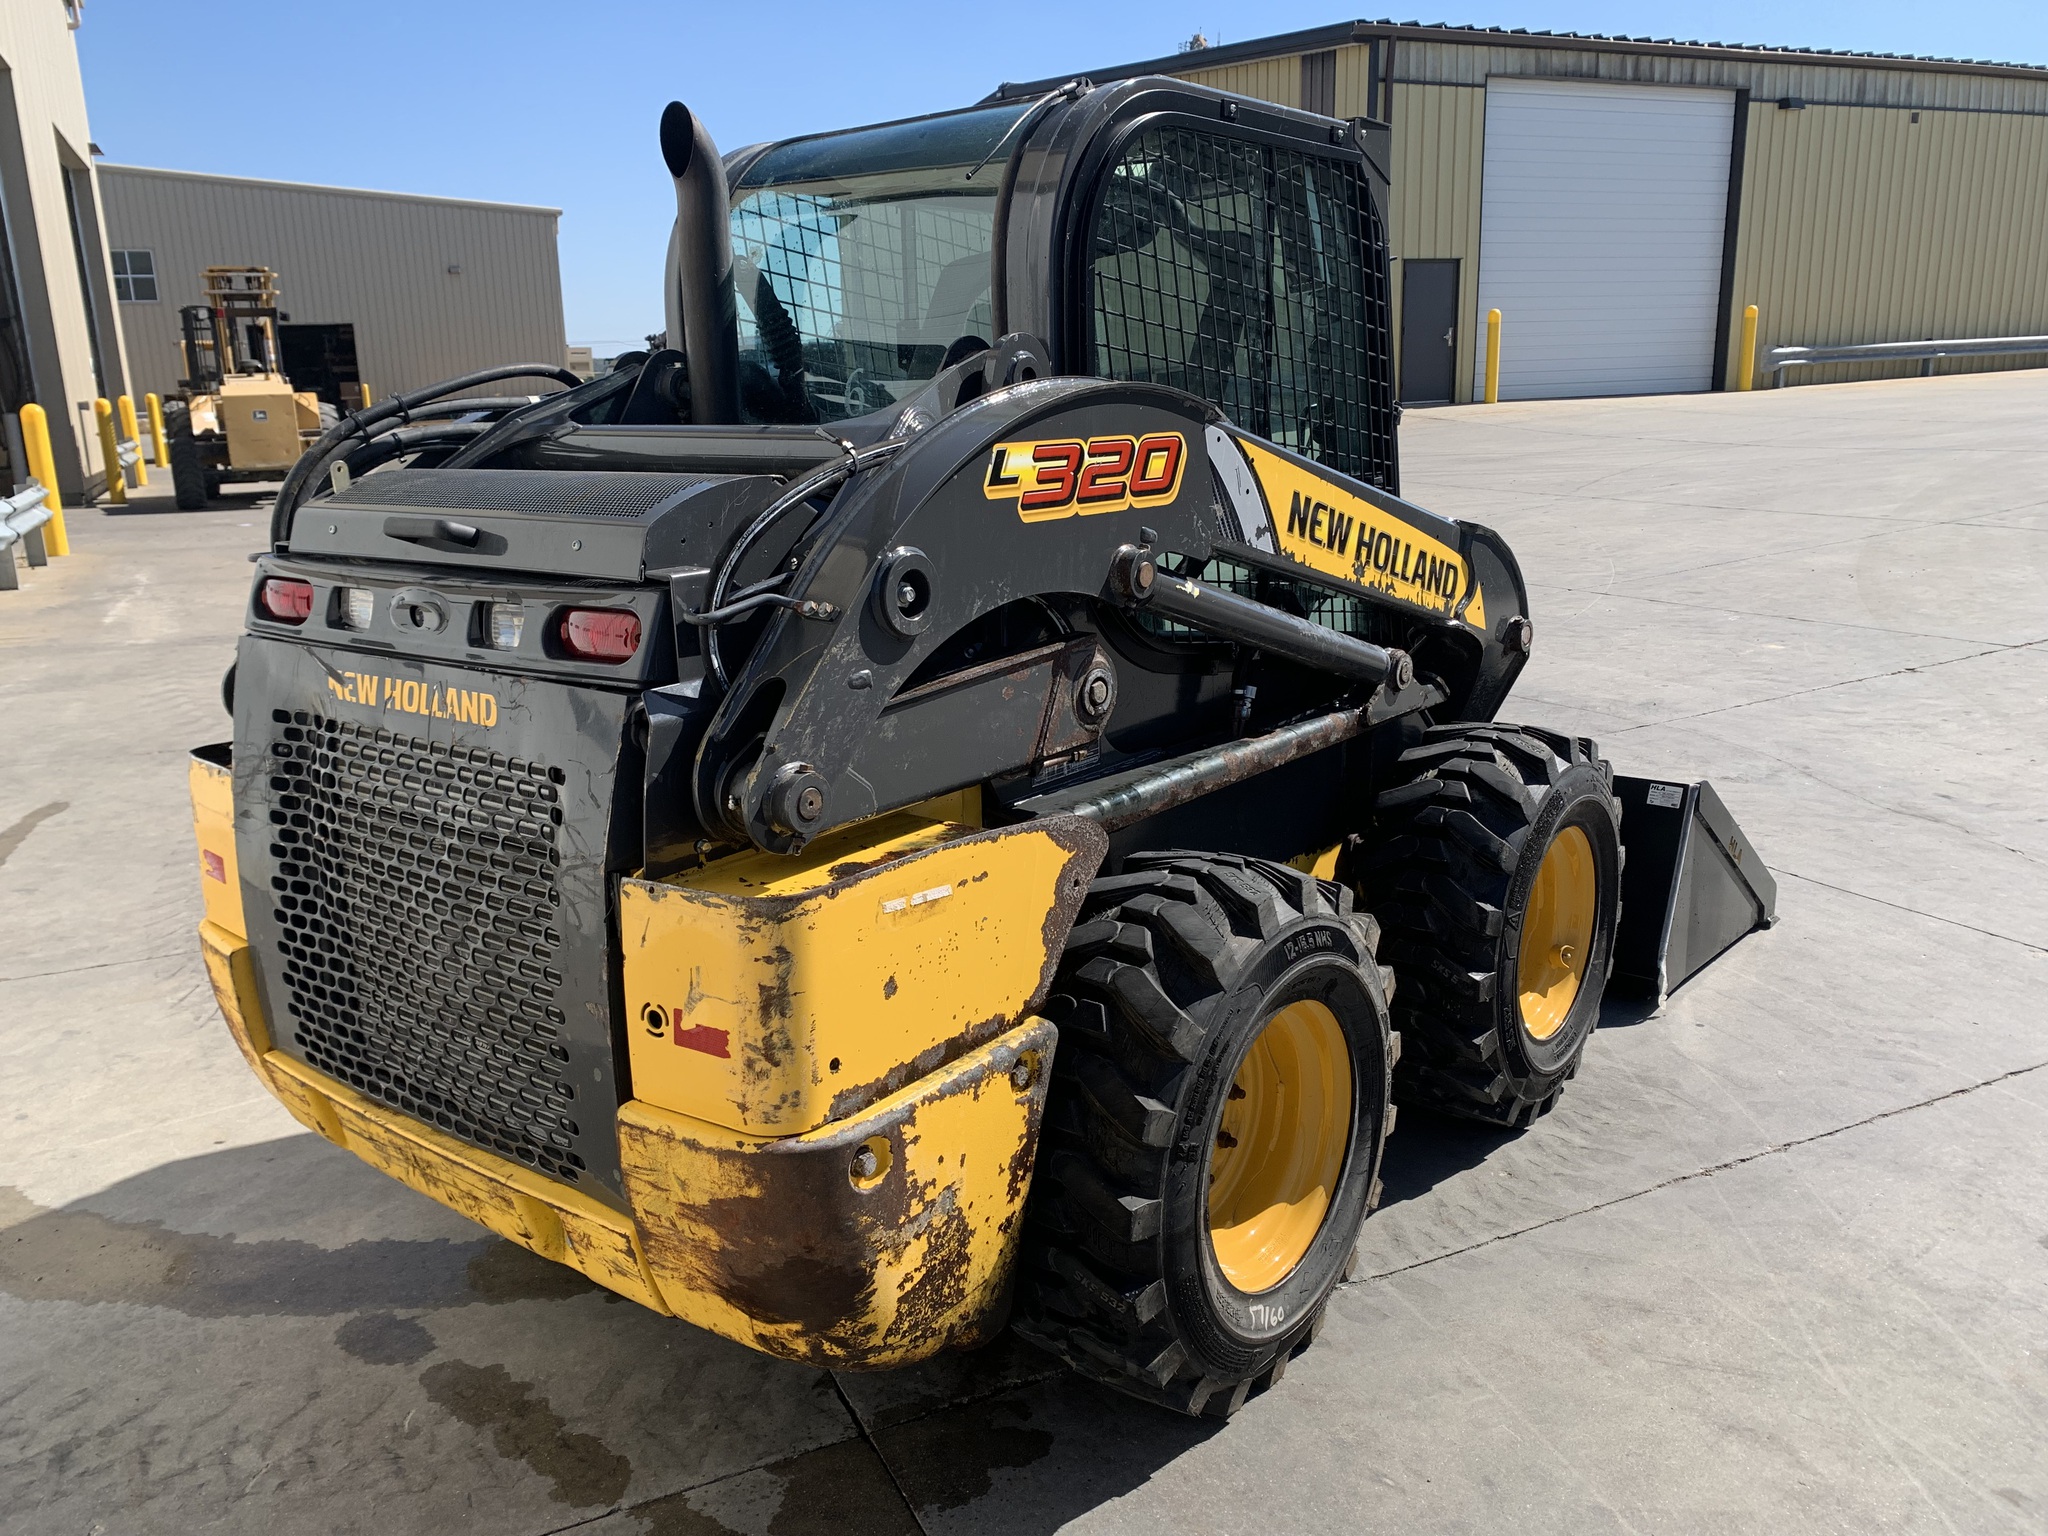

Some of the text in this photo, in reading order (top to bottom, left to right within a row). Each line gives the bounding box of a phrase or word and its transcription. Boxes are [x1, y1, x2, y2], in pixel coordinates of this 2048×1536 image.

[983, 432, 1187, 520] L320
[1287, 490, 1459, 600] NEW HOLLAND
[328, 670, 498, 727] NEW HOLLAND
[1314, 930, 1333, 948] NHS
